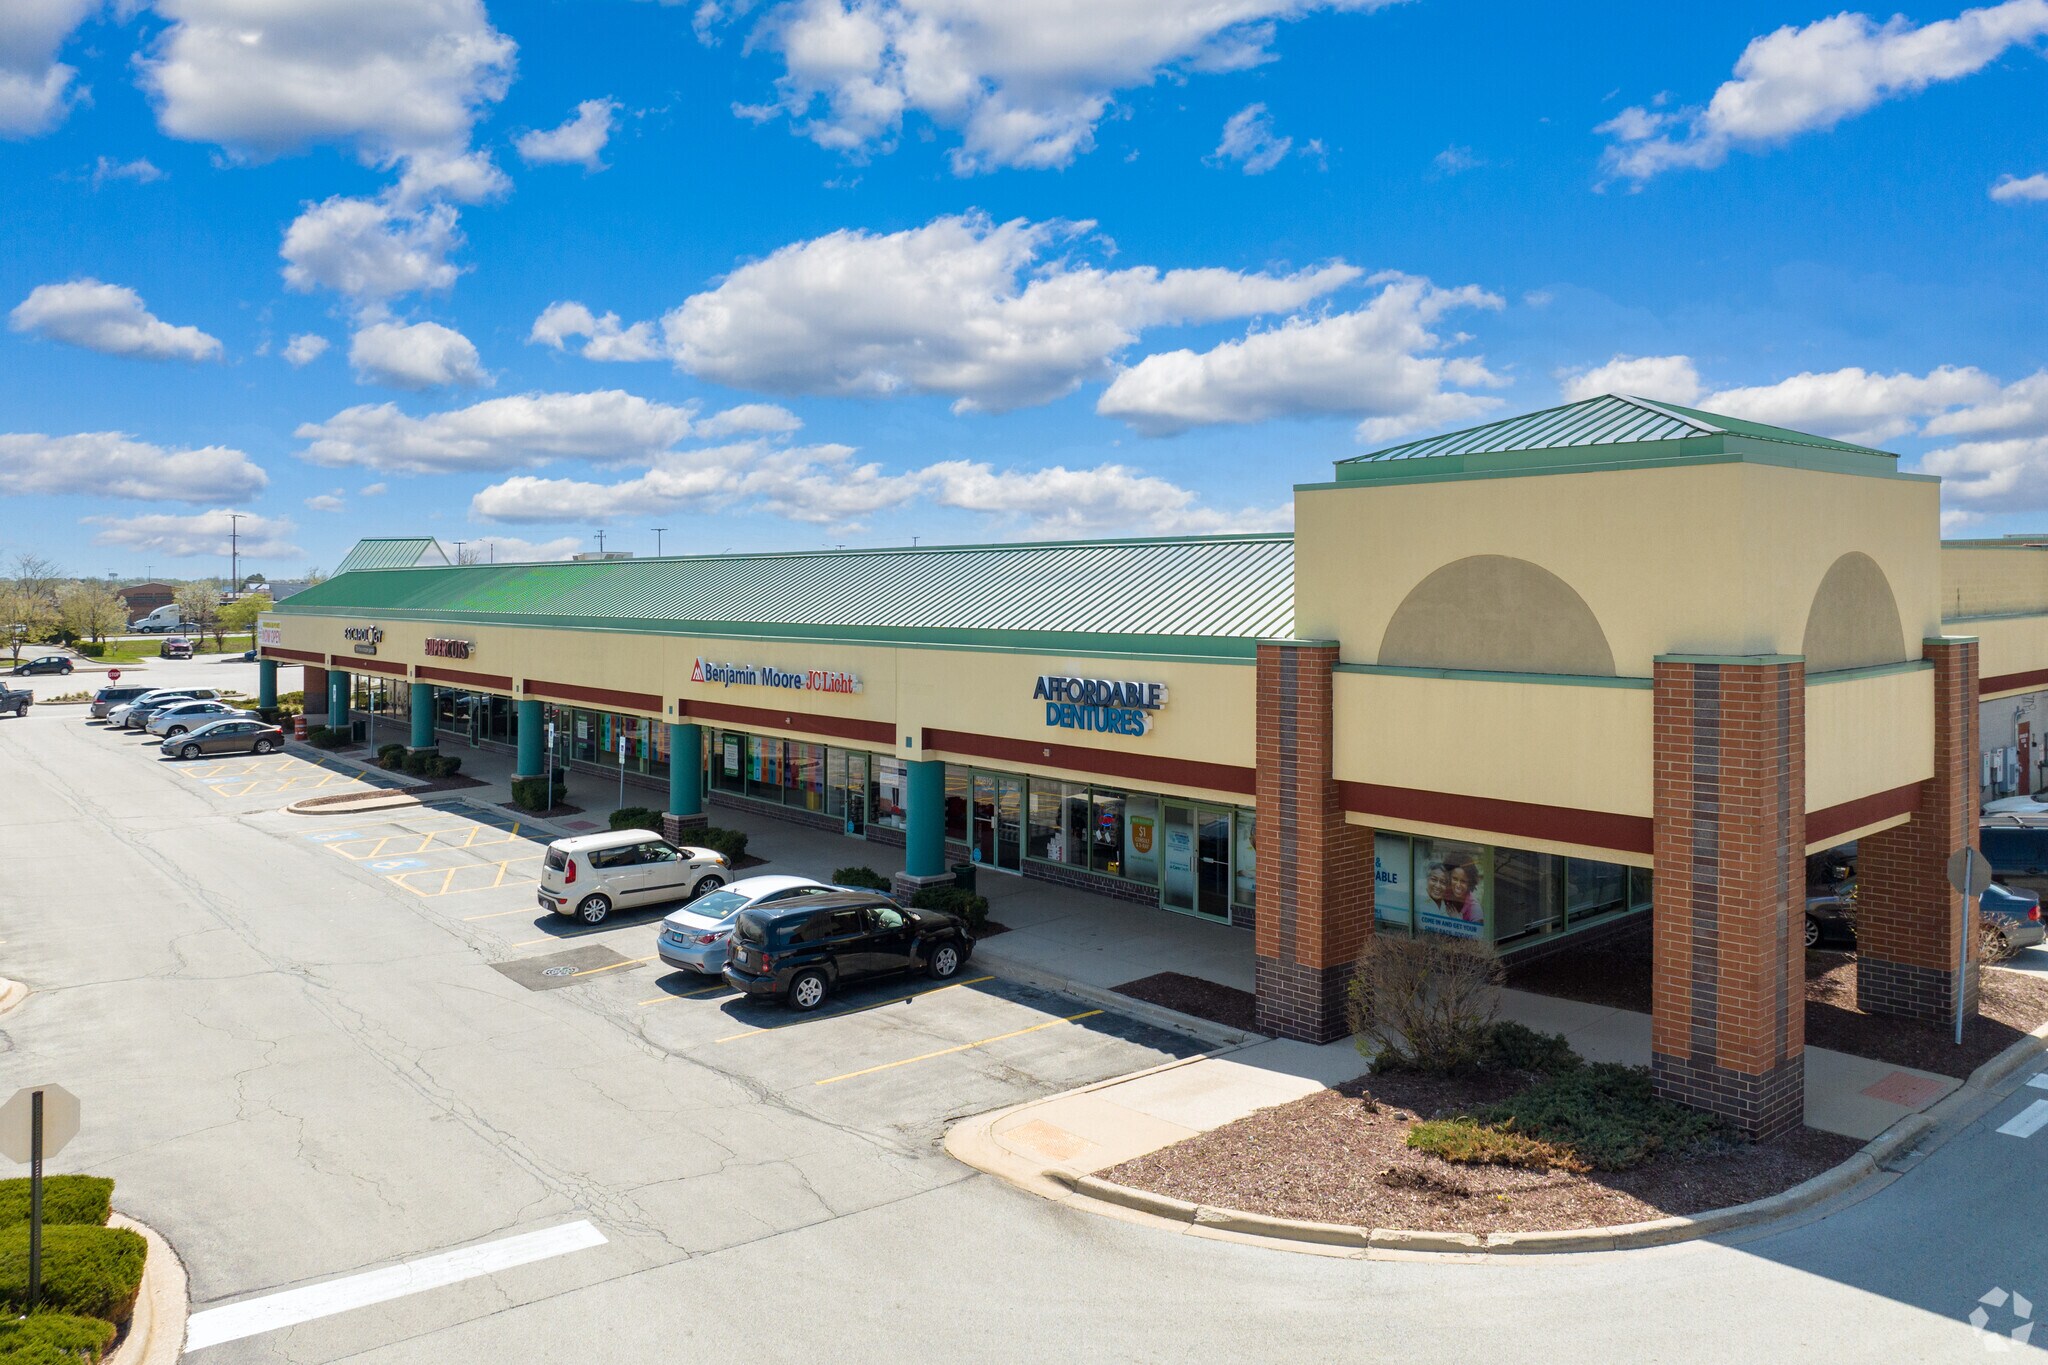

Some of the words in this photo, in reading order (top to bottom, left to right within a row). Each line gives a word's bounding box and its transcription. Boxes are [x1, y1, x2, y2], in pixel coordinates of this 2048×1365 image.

[425, 638, 468, 659] SUPERCUTS
[705, 663, 757, 688] Benjamin
[762, 667, 802, 690] Moore
[1033, 676, 1161, 710] AFFORDABLE
[1046, 702, 1145, 737] DENTURES
[1138, 825, 1146, 838] $1
[1375, 857, 1381, 868] &
[1421, 916, 1435, 925] COME
[1441, 920, 1453, 928] AND
[1453, 922, 1463, 930] GET
[1463, 925, 1477, 933] YOUR
